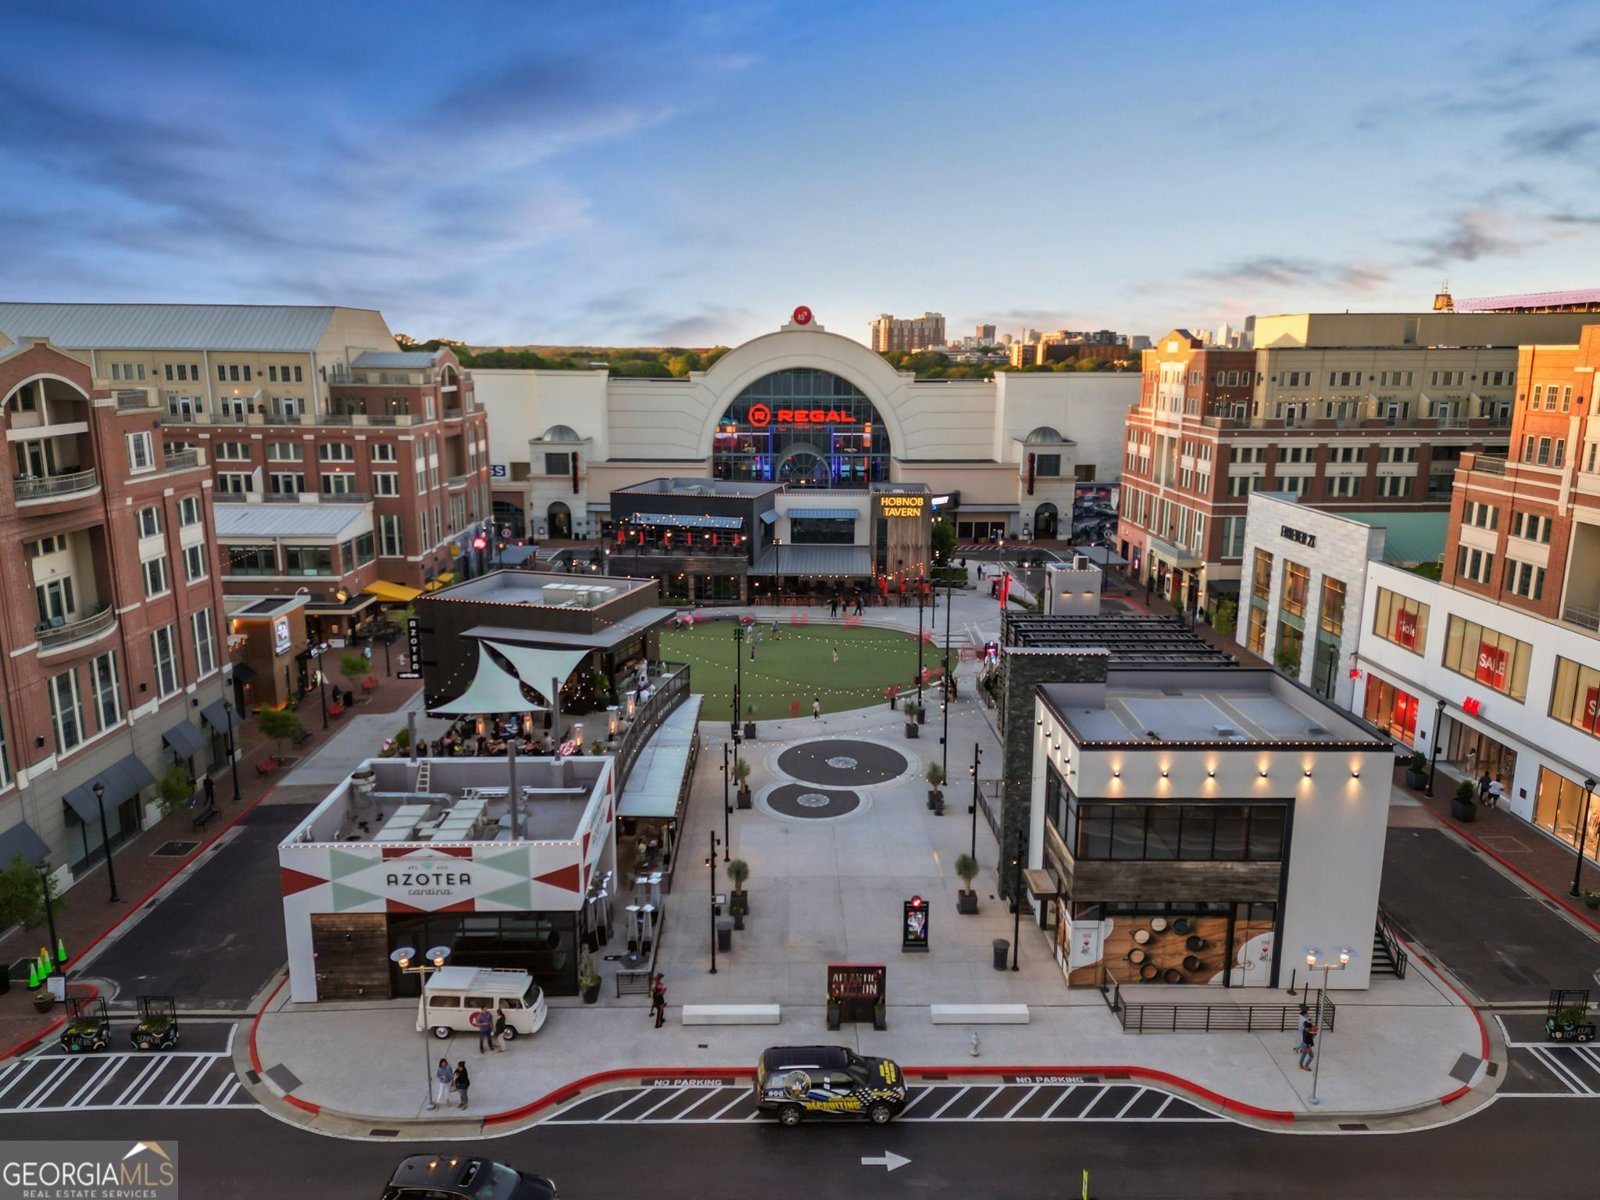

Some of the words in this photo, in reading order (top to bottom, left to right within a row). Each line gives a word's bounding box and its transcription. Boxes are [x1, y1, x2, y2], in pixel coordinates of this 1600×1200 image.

[777, 409, 857, 423] REGAL
[881, 497, 924, 506] HOBNOB
[884, 508, 921, 517] TAVERN
[409, 620, 419, 670] AZOTEA
[1479, 653, 1505, 676] SALE
[386, 873, 471, 886] AZOTEA
[408, 888, 453, 896] cantina
